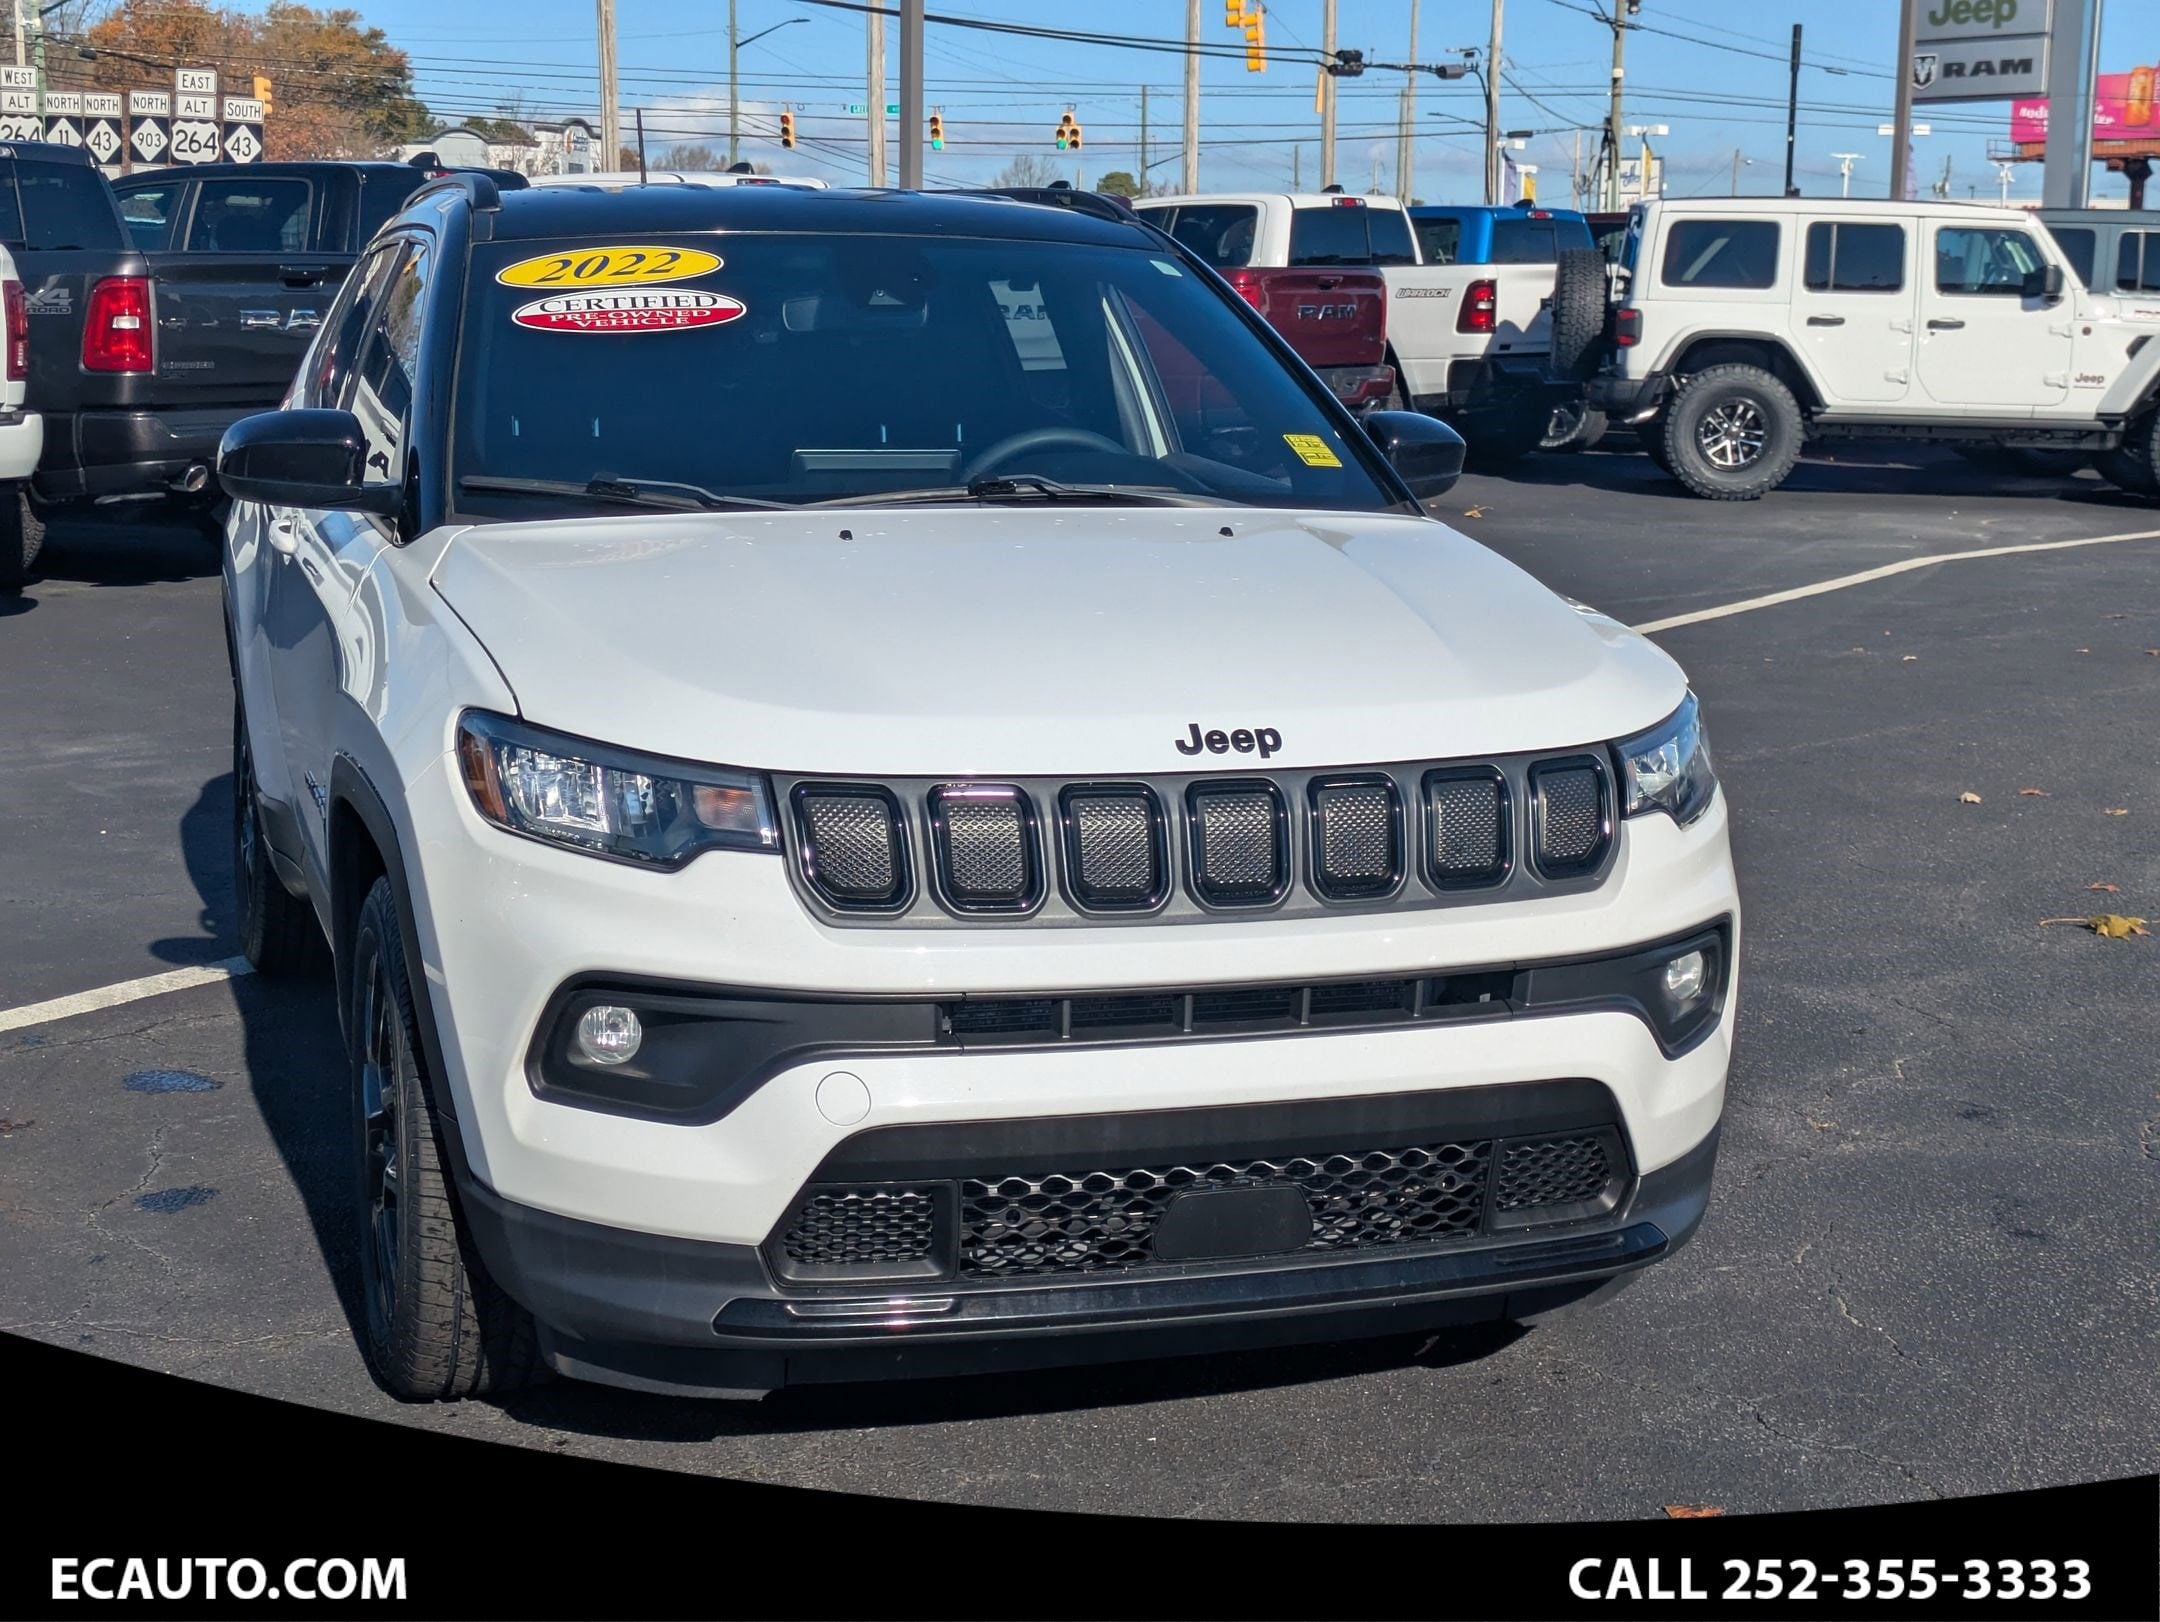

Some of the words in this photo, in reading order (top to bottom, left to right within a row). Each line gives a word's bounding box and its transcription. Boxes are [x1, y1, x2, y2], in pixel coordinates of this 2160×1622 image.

[1928, 0, 2017, 29] Jeep
[1943, 58, 2033, 78] RAM
[4, 69, 33, 85] WEST
[182, 73, 211, 90] EAST
[8, 95, 31, 109] ALT
[46, 96, 80, 110] NORTH
[86, 98, 119, 112] NORTH
[133, 97, 167, 110] NORTH
[184, 100, 208, 114] ALT
[227, 102, 262, 119] SOUTH
[58, 129, 69, 144] 11
[92, 131, 111, 151] 43
[137, 132, 162, 147] 903
[175, 129, 217, 154] 264
[230, 137, 251, 156] 43
[534, 252, 682, 283] 2022
[540, 295, 718, 313] CERTIFIED
[1297, 304, 1357, 320] RAM
[550, 309, 711, 322] PRE-OWNED
[573, 317, 690, 328] VEHICLE
[2075, 373, 2105, 385] Jeep
[1175, 723, 1282, 759] Jeep
